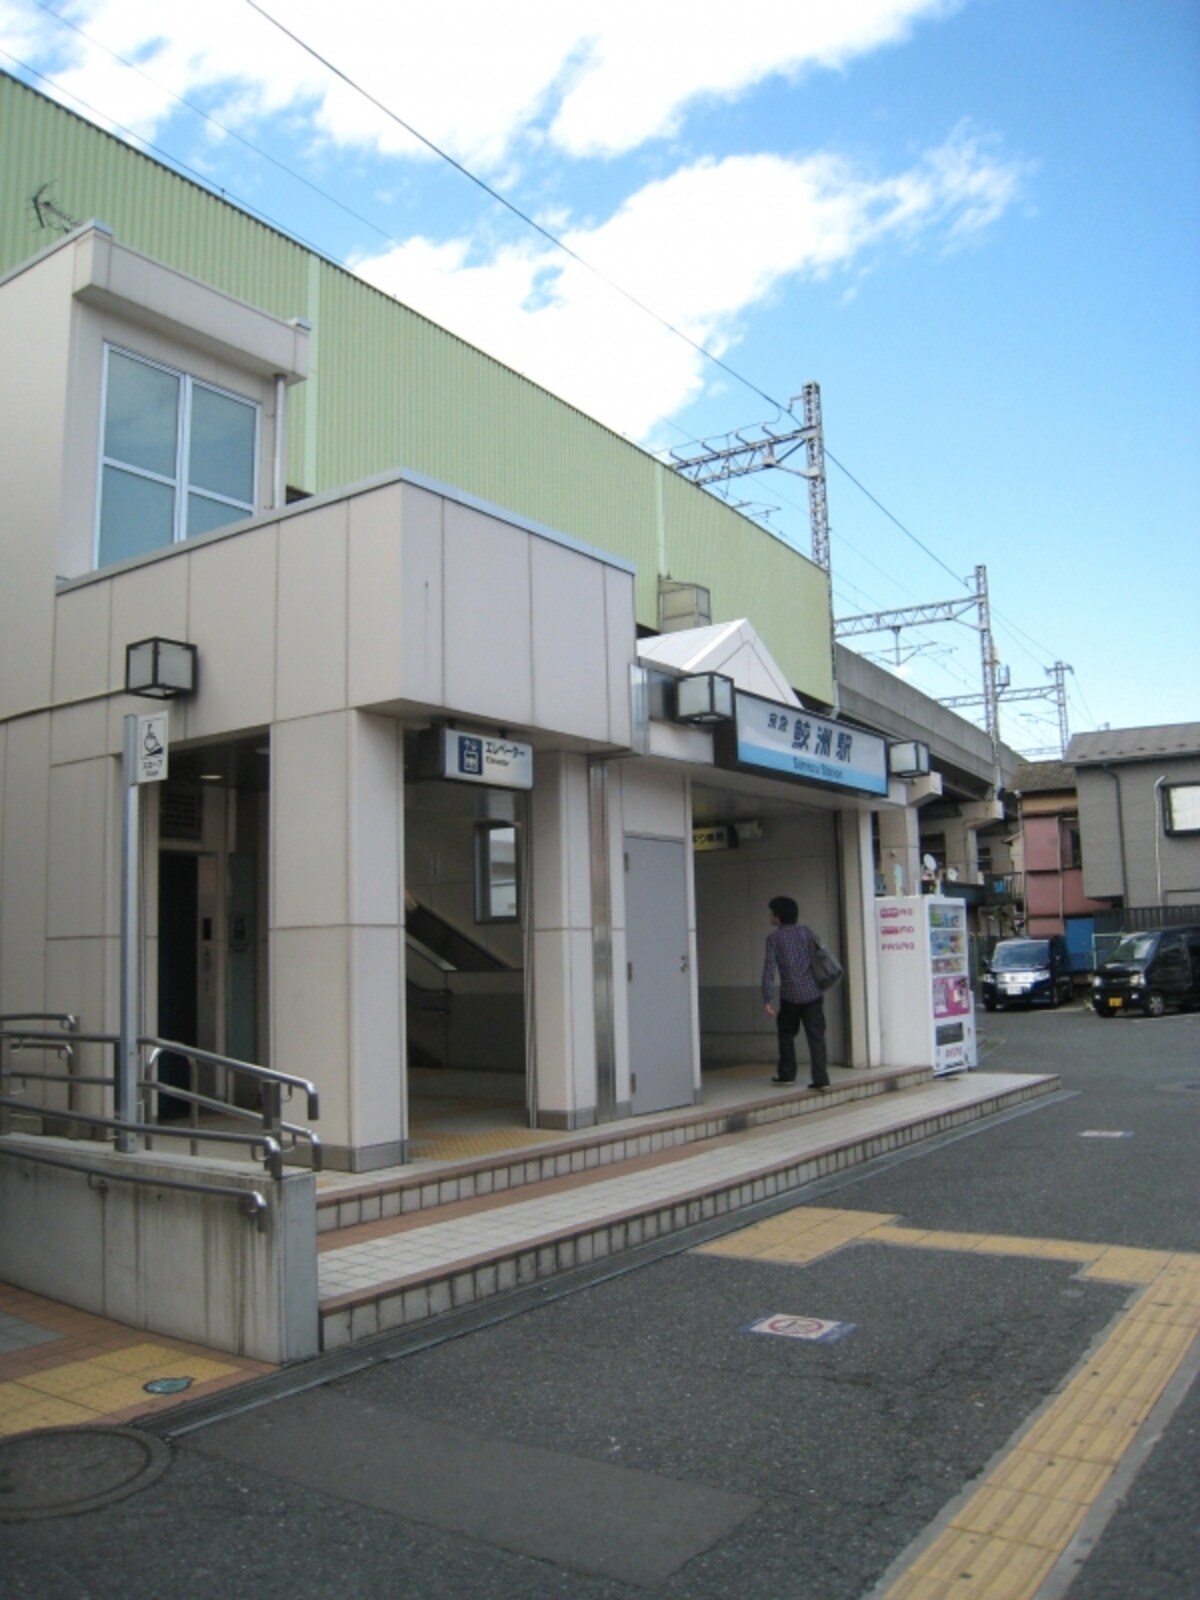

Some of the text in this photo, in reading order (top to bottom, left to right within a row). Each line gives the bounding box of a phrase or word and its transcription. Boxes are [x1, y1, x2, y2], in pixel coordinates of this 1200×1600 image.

[486, 741, 525, 759] エレベーター
[792, 718, 852, 763] 鮫洲駅
